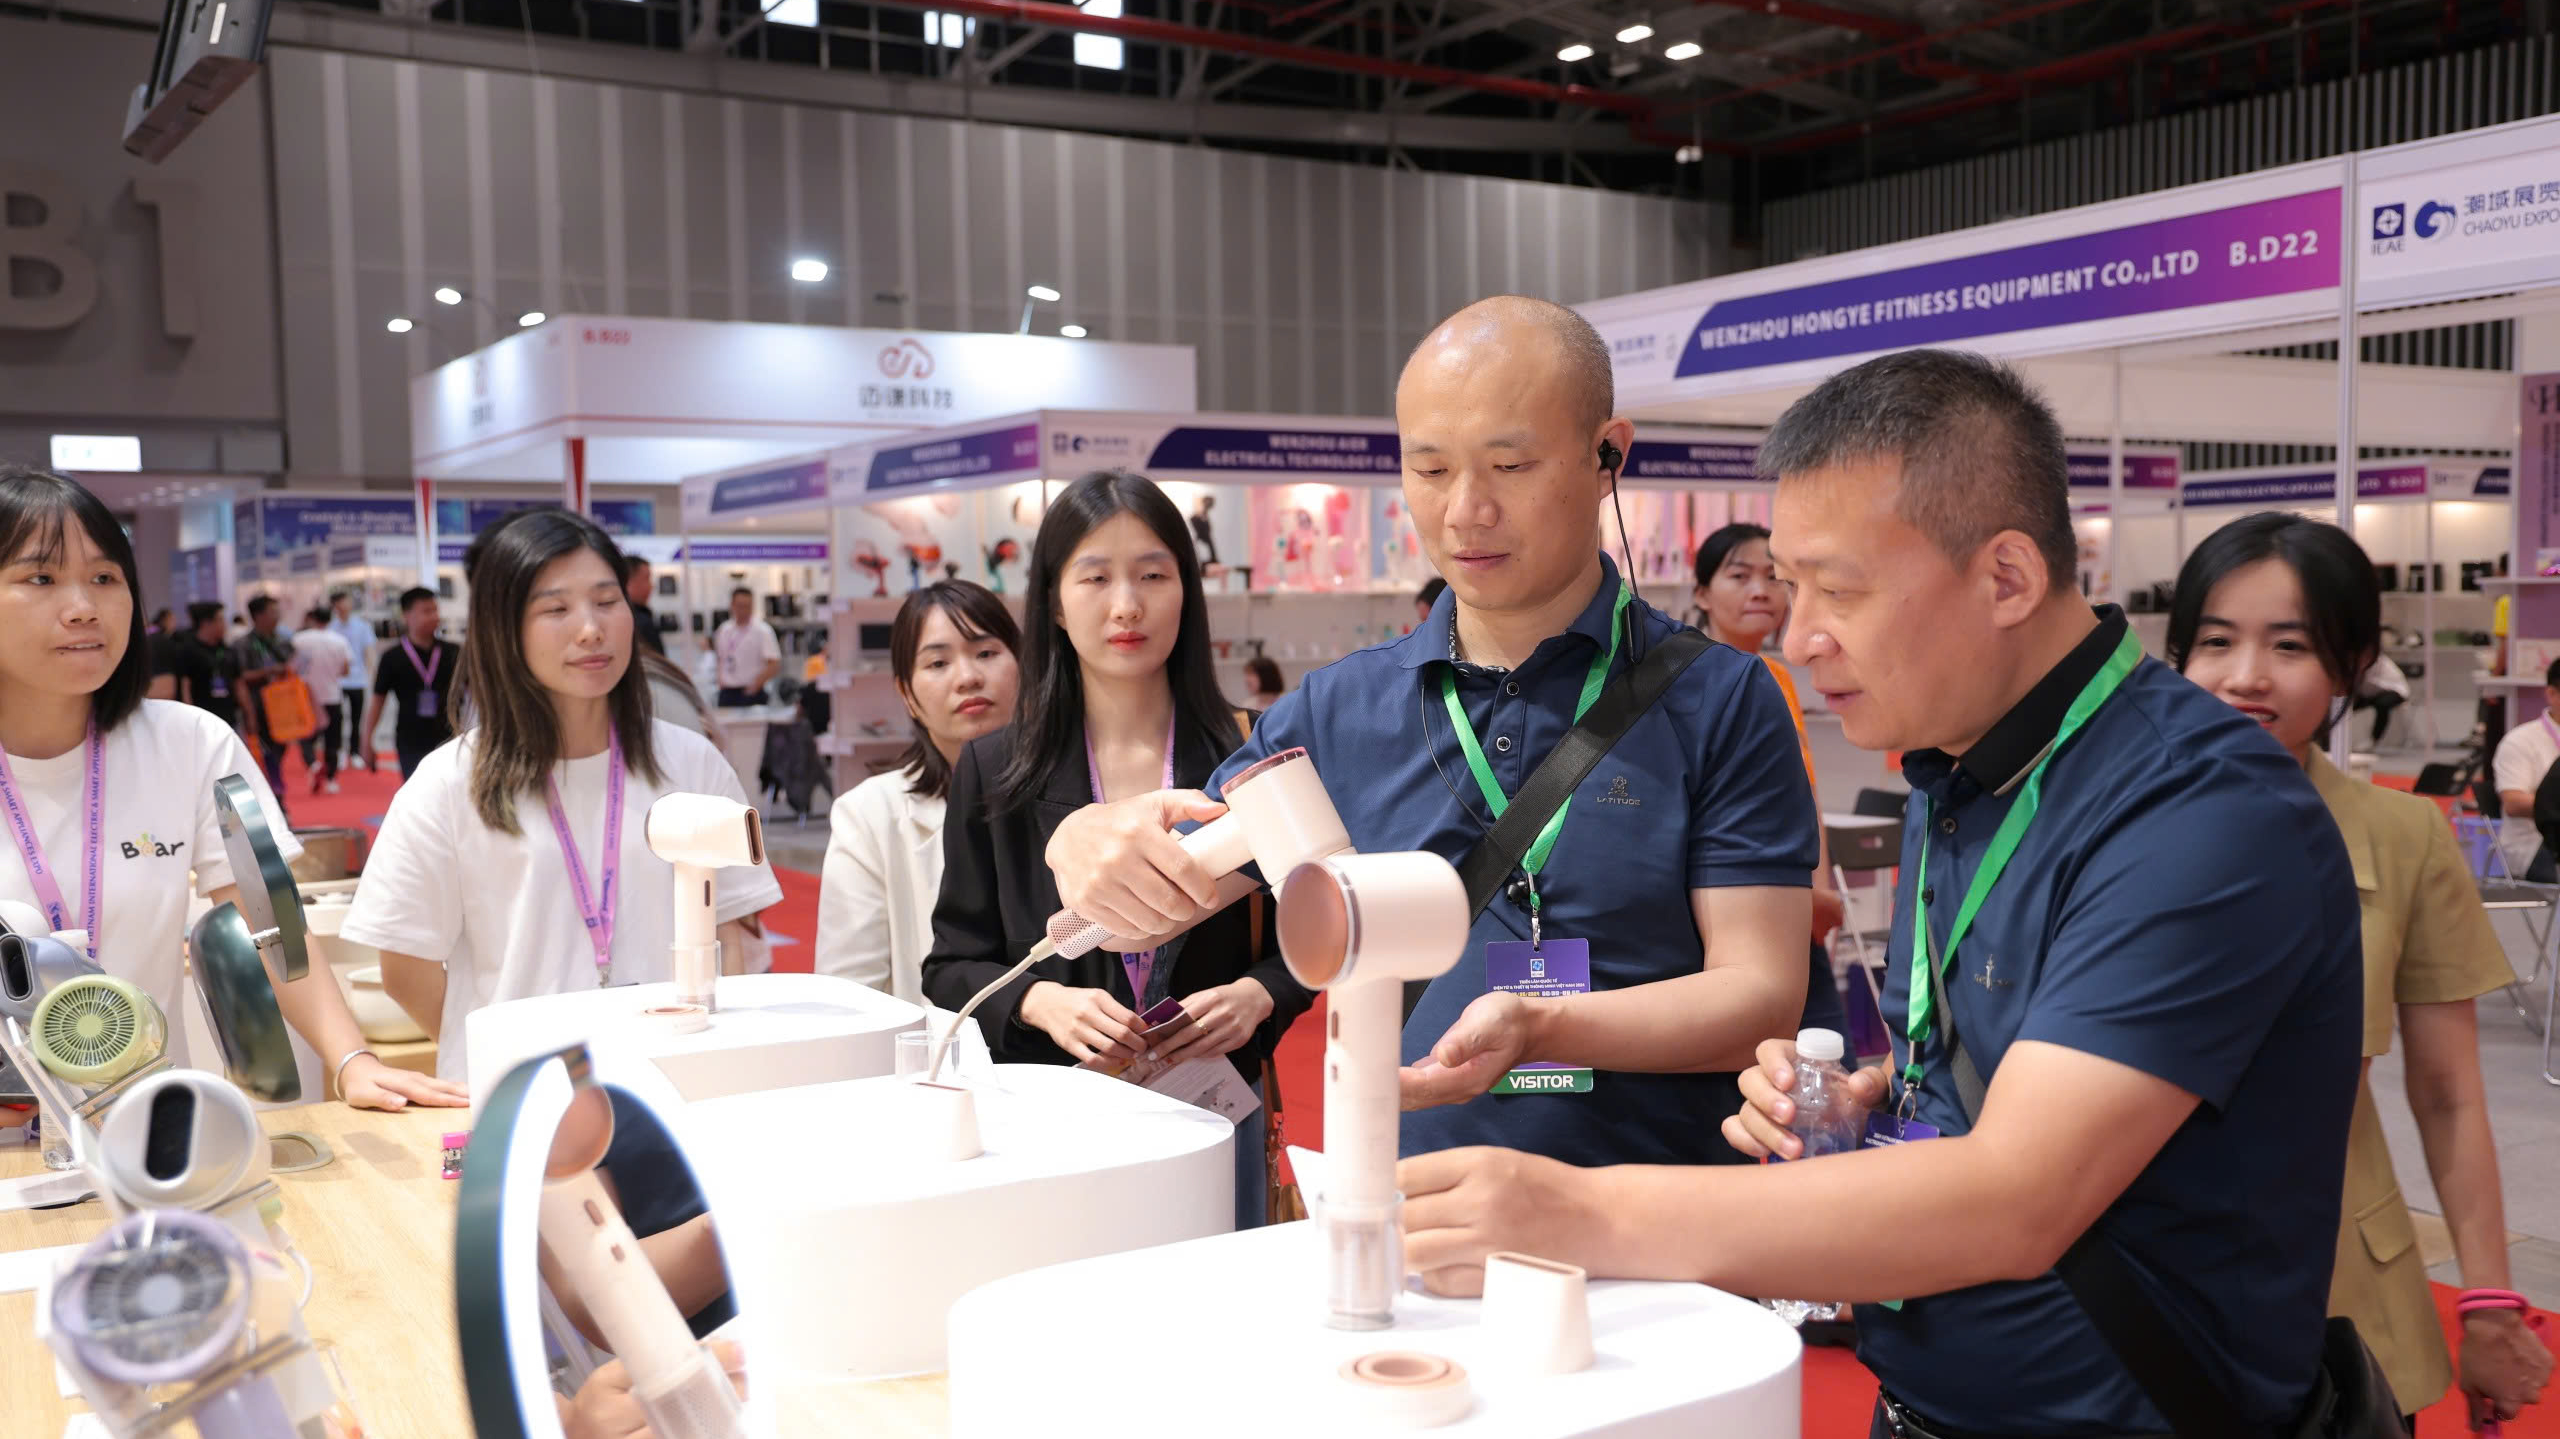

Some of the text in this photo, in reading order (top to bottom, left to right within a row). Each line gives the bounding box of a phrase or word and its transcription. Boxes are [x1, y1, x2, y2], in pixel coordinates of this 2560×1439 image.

[2463, 208, 2560, 237] CHAOYU EXPO
[1700, 230, 2319, 350] WENZHOU HONGYE FITNESS EQUIPMENT CO.,LTD B.D22
[92, 777, 100, 801] SMART
[1597, 797, 1641, 806] LATITUDE
[2, 786, 18, 811] SMART
[13, 811, 37, 857] APPLIANCES
[30, 855, 43, 875] EXPO
[90, 809, 99, 844] ELECTRIC
[88, 847, 98, 904] INTERNATIONAL
[1509, 1075, 1575, 1089] VISITOR
